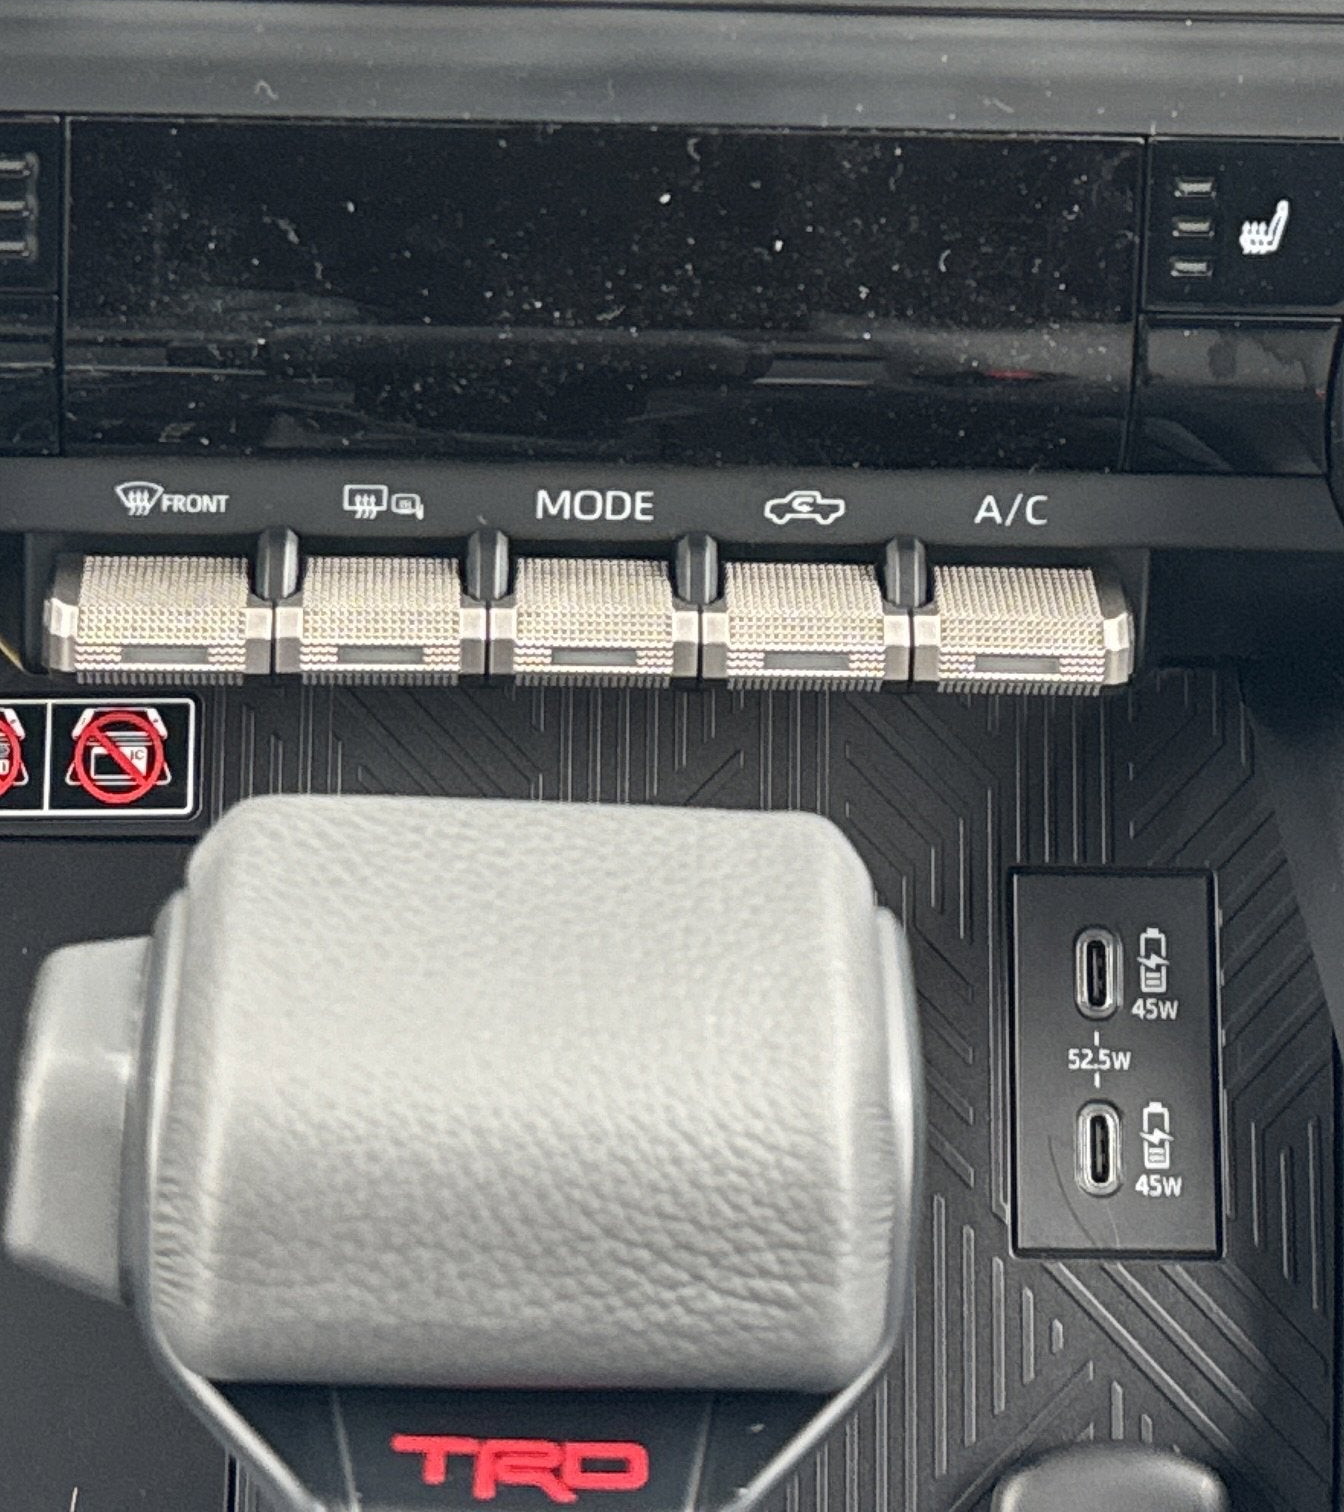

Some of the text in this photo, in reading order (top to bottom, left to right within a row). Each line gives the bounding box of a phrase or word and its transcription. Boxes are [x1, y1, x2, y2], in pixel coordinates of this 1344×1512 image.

[160, 494, 230, 514] FRONT
[535, 489, 655, 521] MODE
[973, 494, 1048, 527] A/C
[1131, 998, 1179, 1021] 45W
[1067, 1048, 1132, 1072] 52.5W
[1134, 1174, 1183, 1198] 45W
[390, 1433, 649, 1504] TRD
